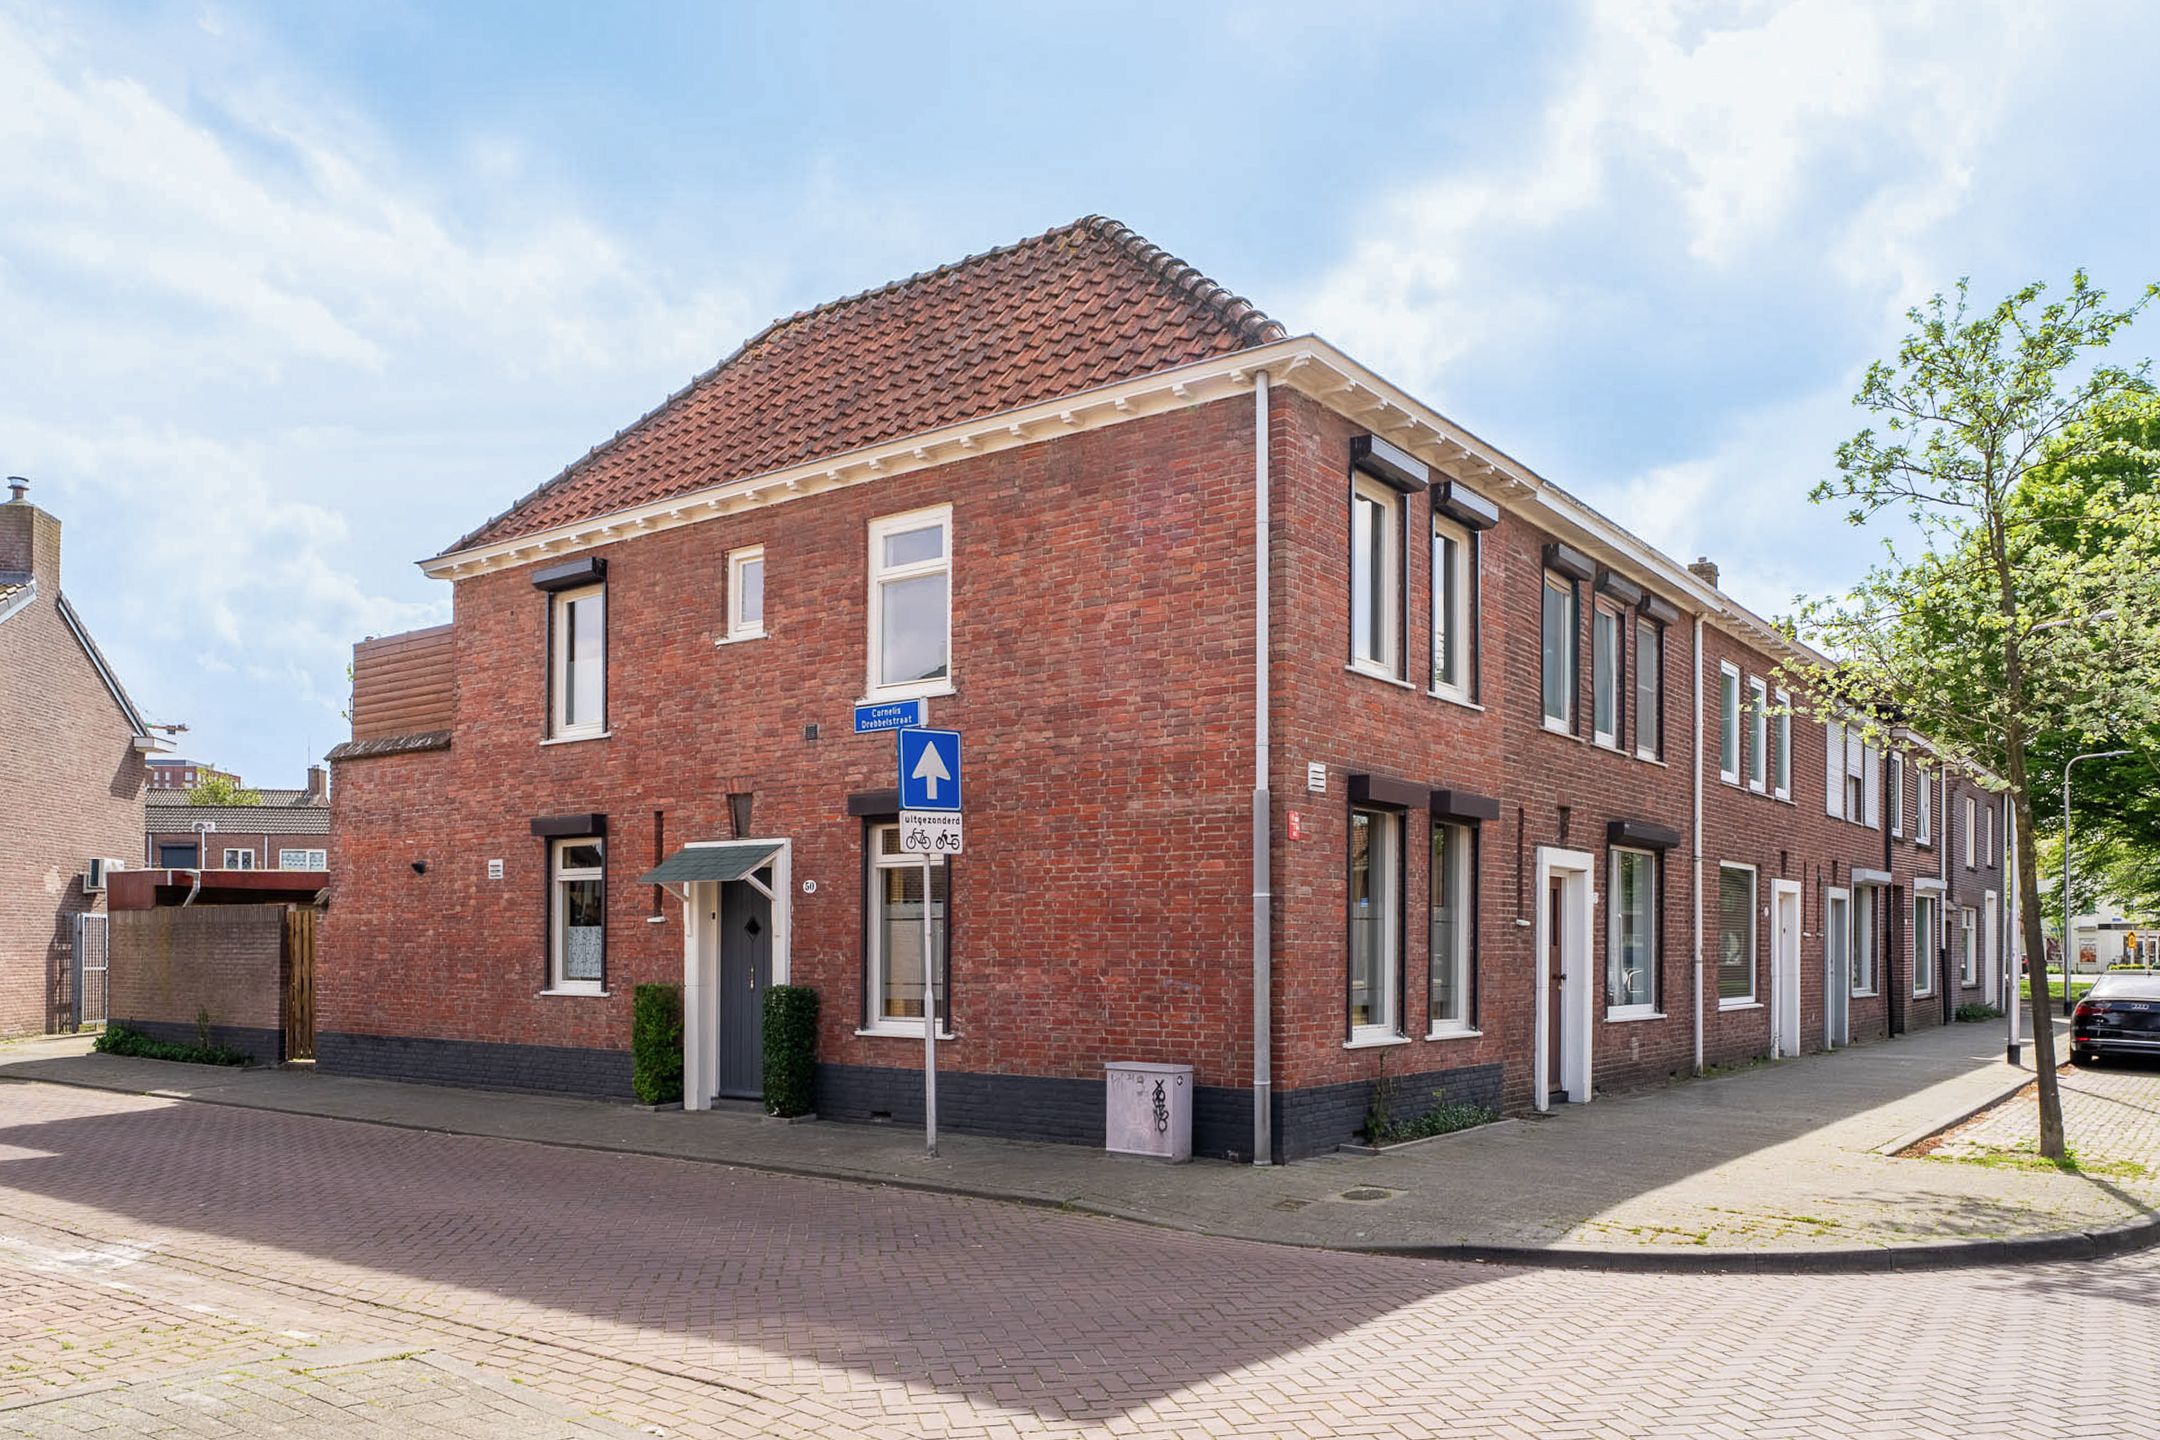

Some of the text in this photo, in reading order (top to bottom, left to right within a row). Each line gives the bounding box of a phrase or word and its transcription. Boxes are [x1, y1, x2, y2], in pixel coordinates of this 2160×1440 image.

[871, 706, 902, 718] Cornelis
[861, 714, 913, 729] Drebbelstraat
[904, 815, 960, 827] uitgezonderd
[805, 881, 815, 891] 50
